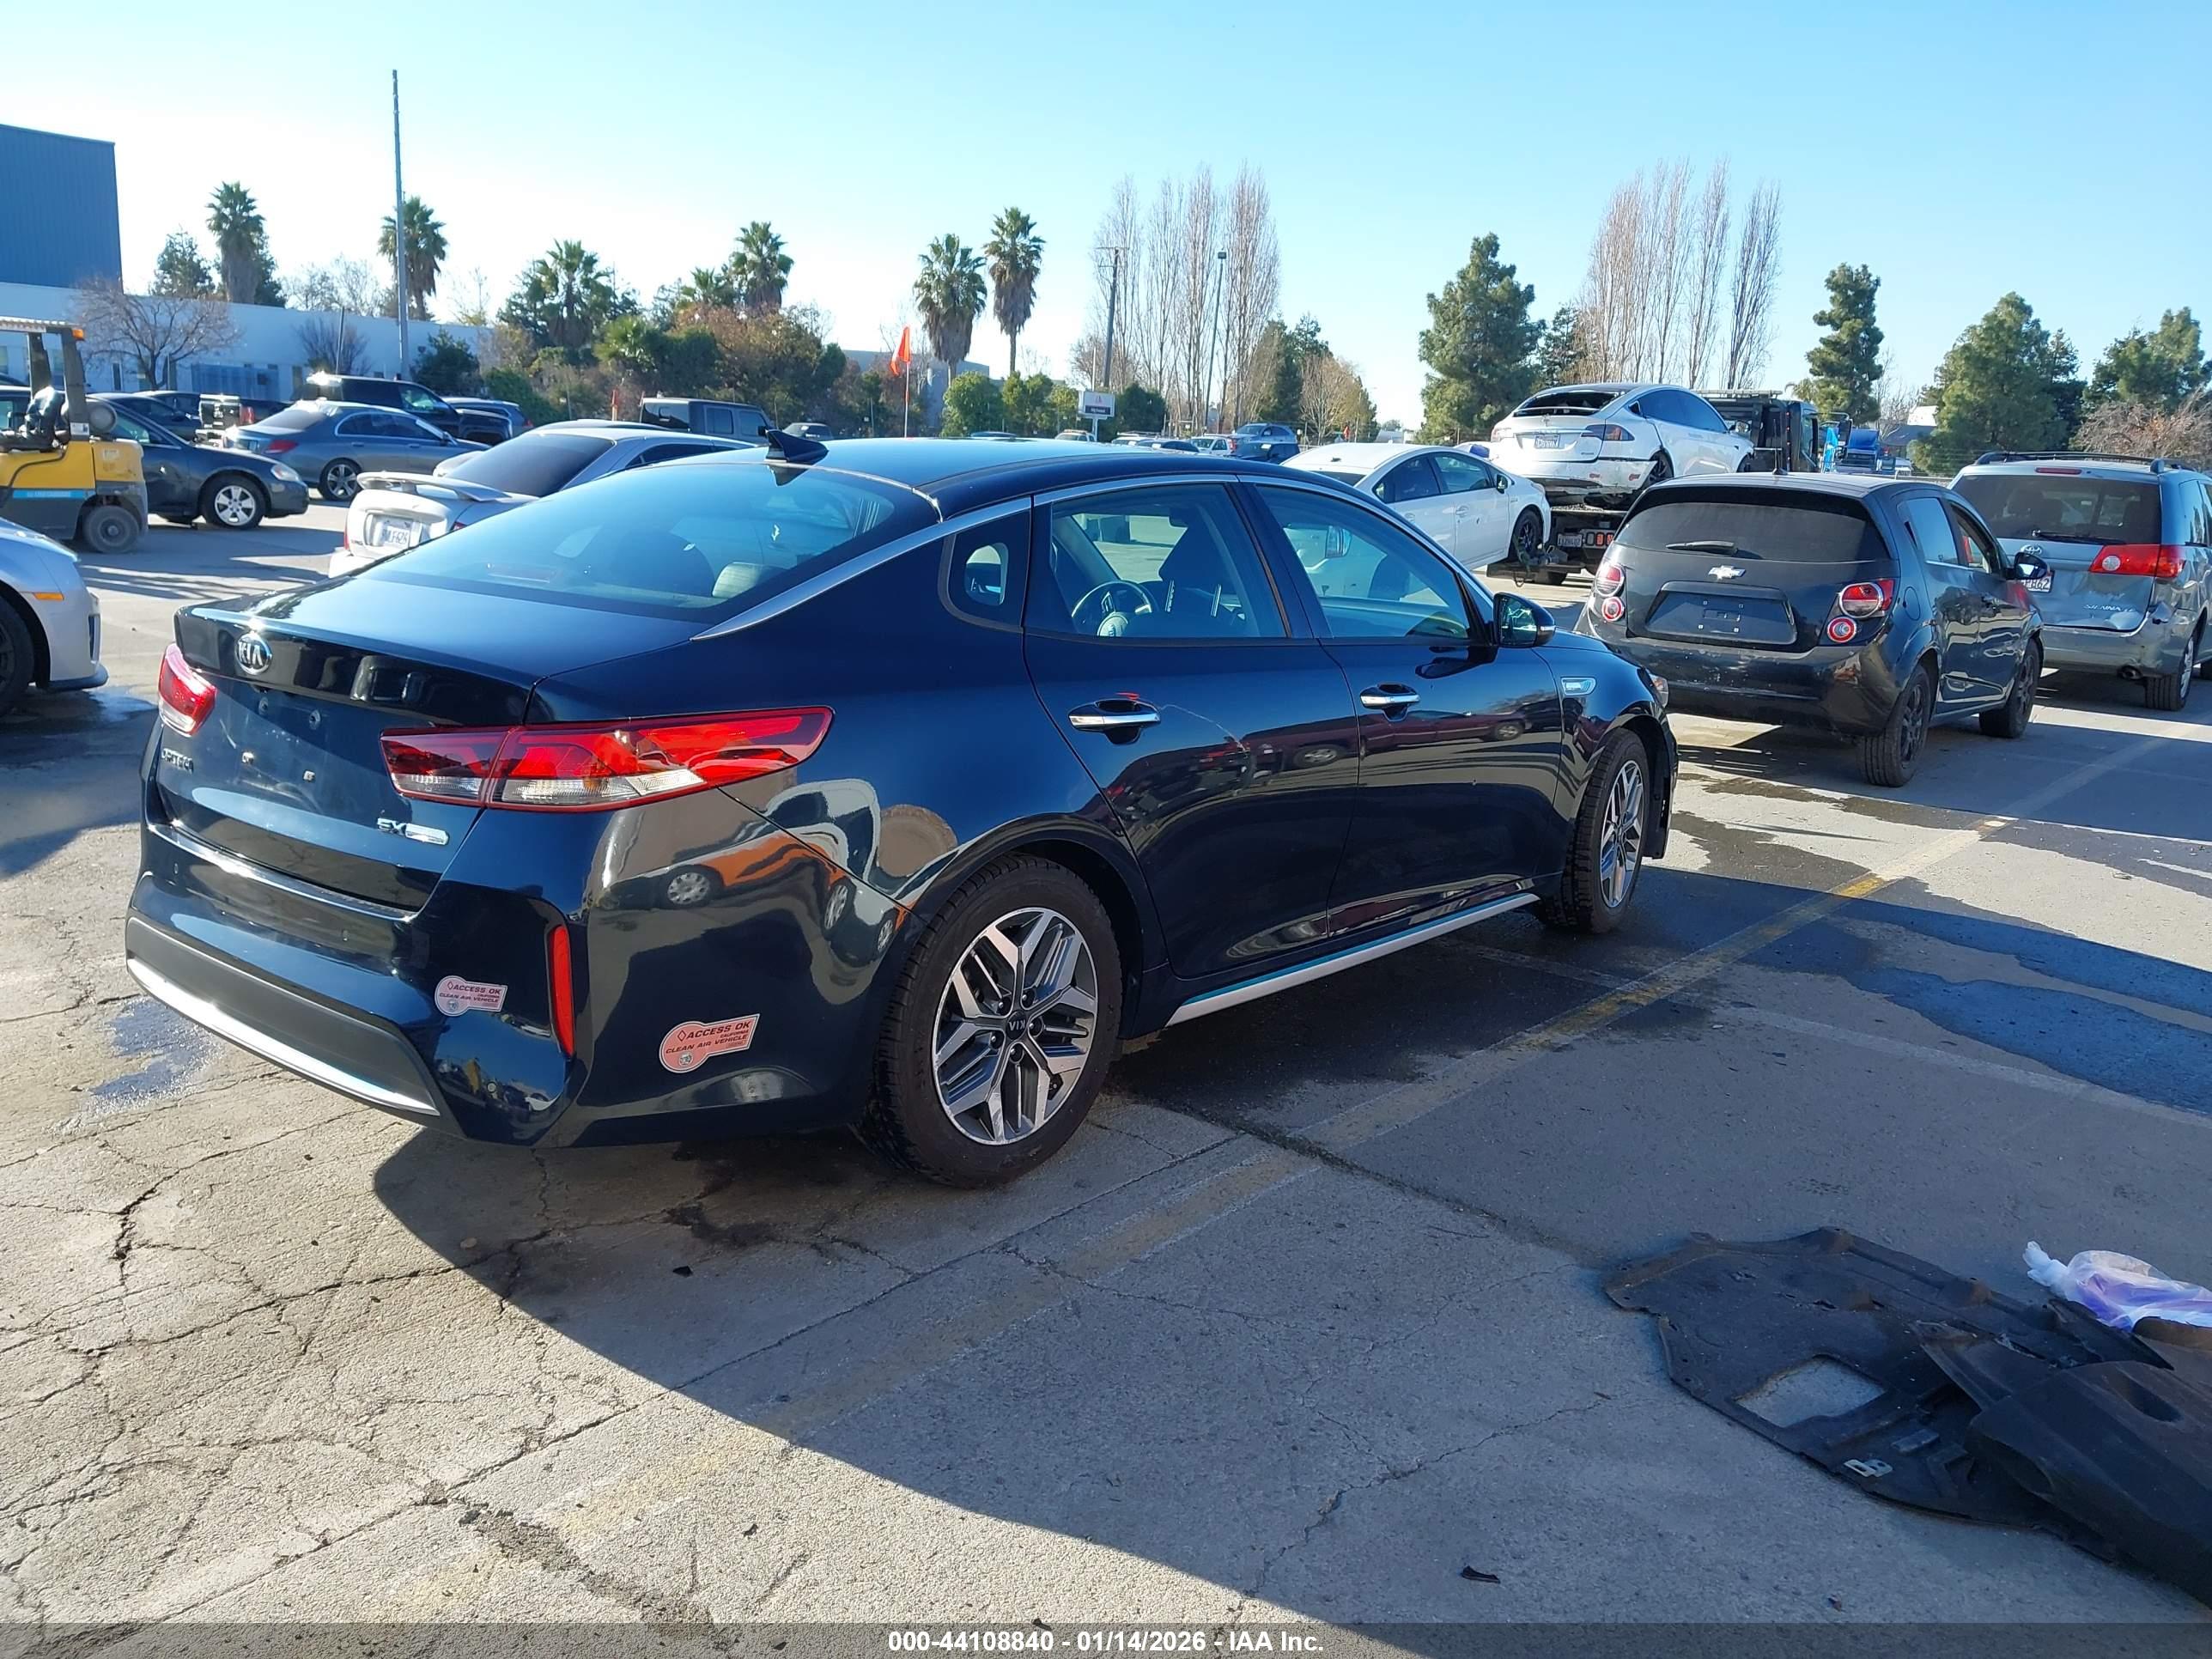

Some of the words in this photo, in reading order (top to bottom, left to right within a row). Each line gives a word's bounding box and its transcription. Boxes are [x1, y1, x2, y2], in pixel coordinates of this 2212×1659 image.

[237, 641, 264, 667] KIA
[377, 817, 407, 836] EX
[453, 984, 486, 994] ACCESS
[686, 1024, 732, 1039] ACCESS
[735, 1021, 750, 1030] OK
[1009, 1019, 1025, 1030] KIA
[665, 1044, 695, 1054] CLEAN
[714, 1034, 748, 1045] VEHICLE
